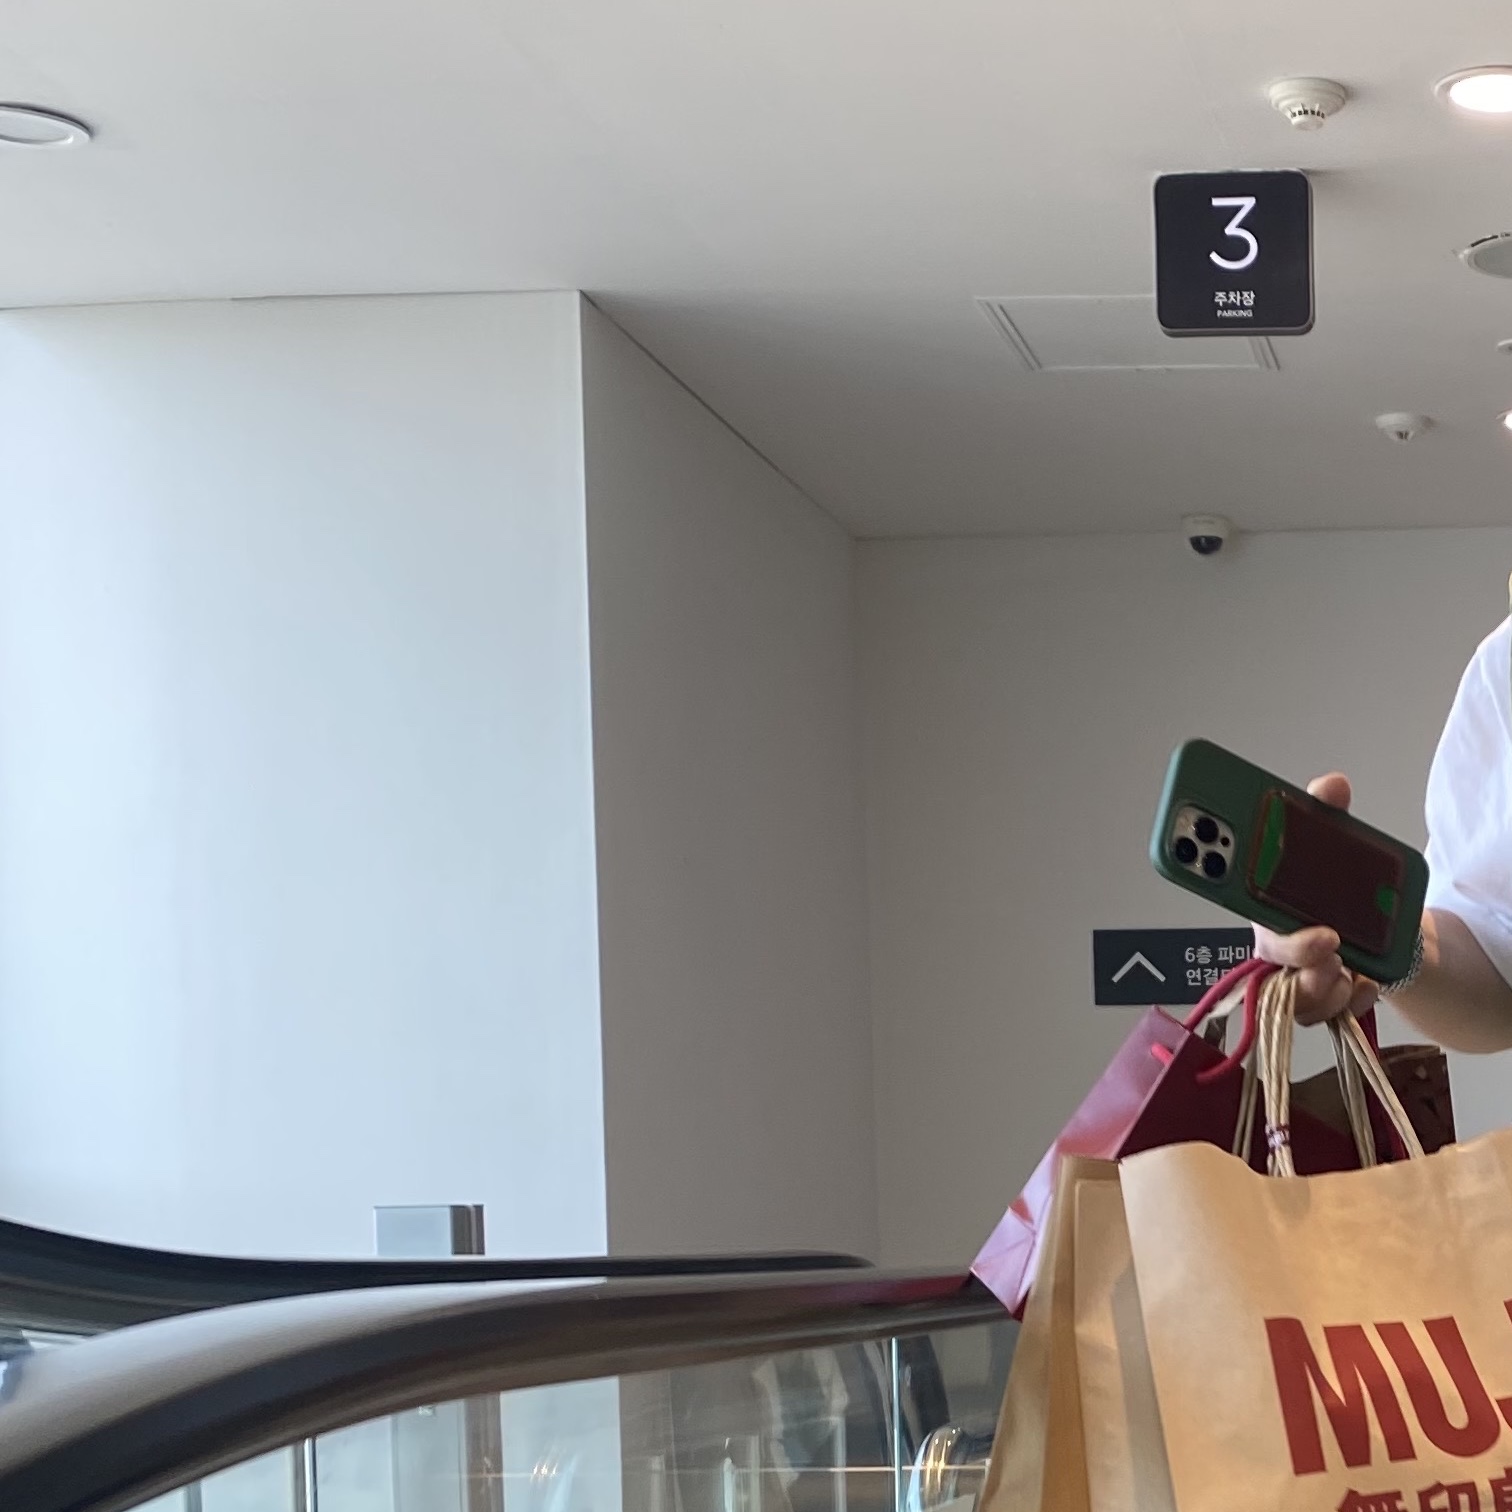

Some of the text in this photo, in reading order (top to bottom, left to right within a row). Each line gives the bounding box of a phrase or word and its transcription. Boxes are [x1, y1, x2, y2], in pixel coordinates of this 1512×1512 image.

[1209, 196, 1259, 270] 3
[1214, 290, 1256, 306] 주차장
[1216, 309, 1253, 318] PARKING
[1184, 945, 1213, 965] 6층
